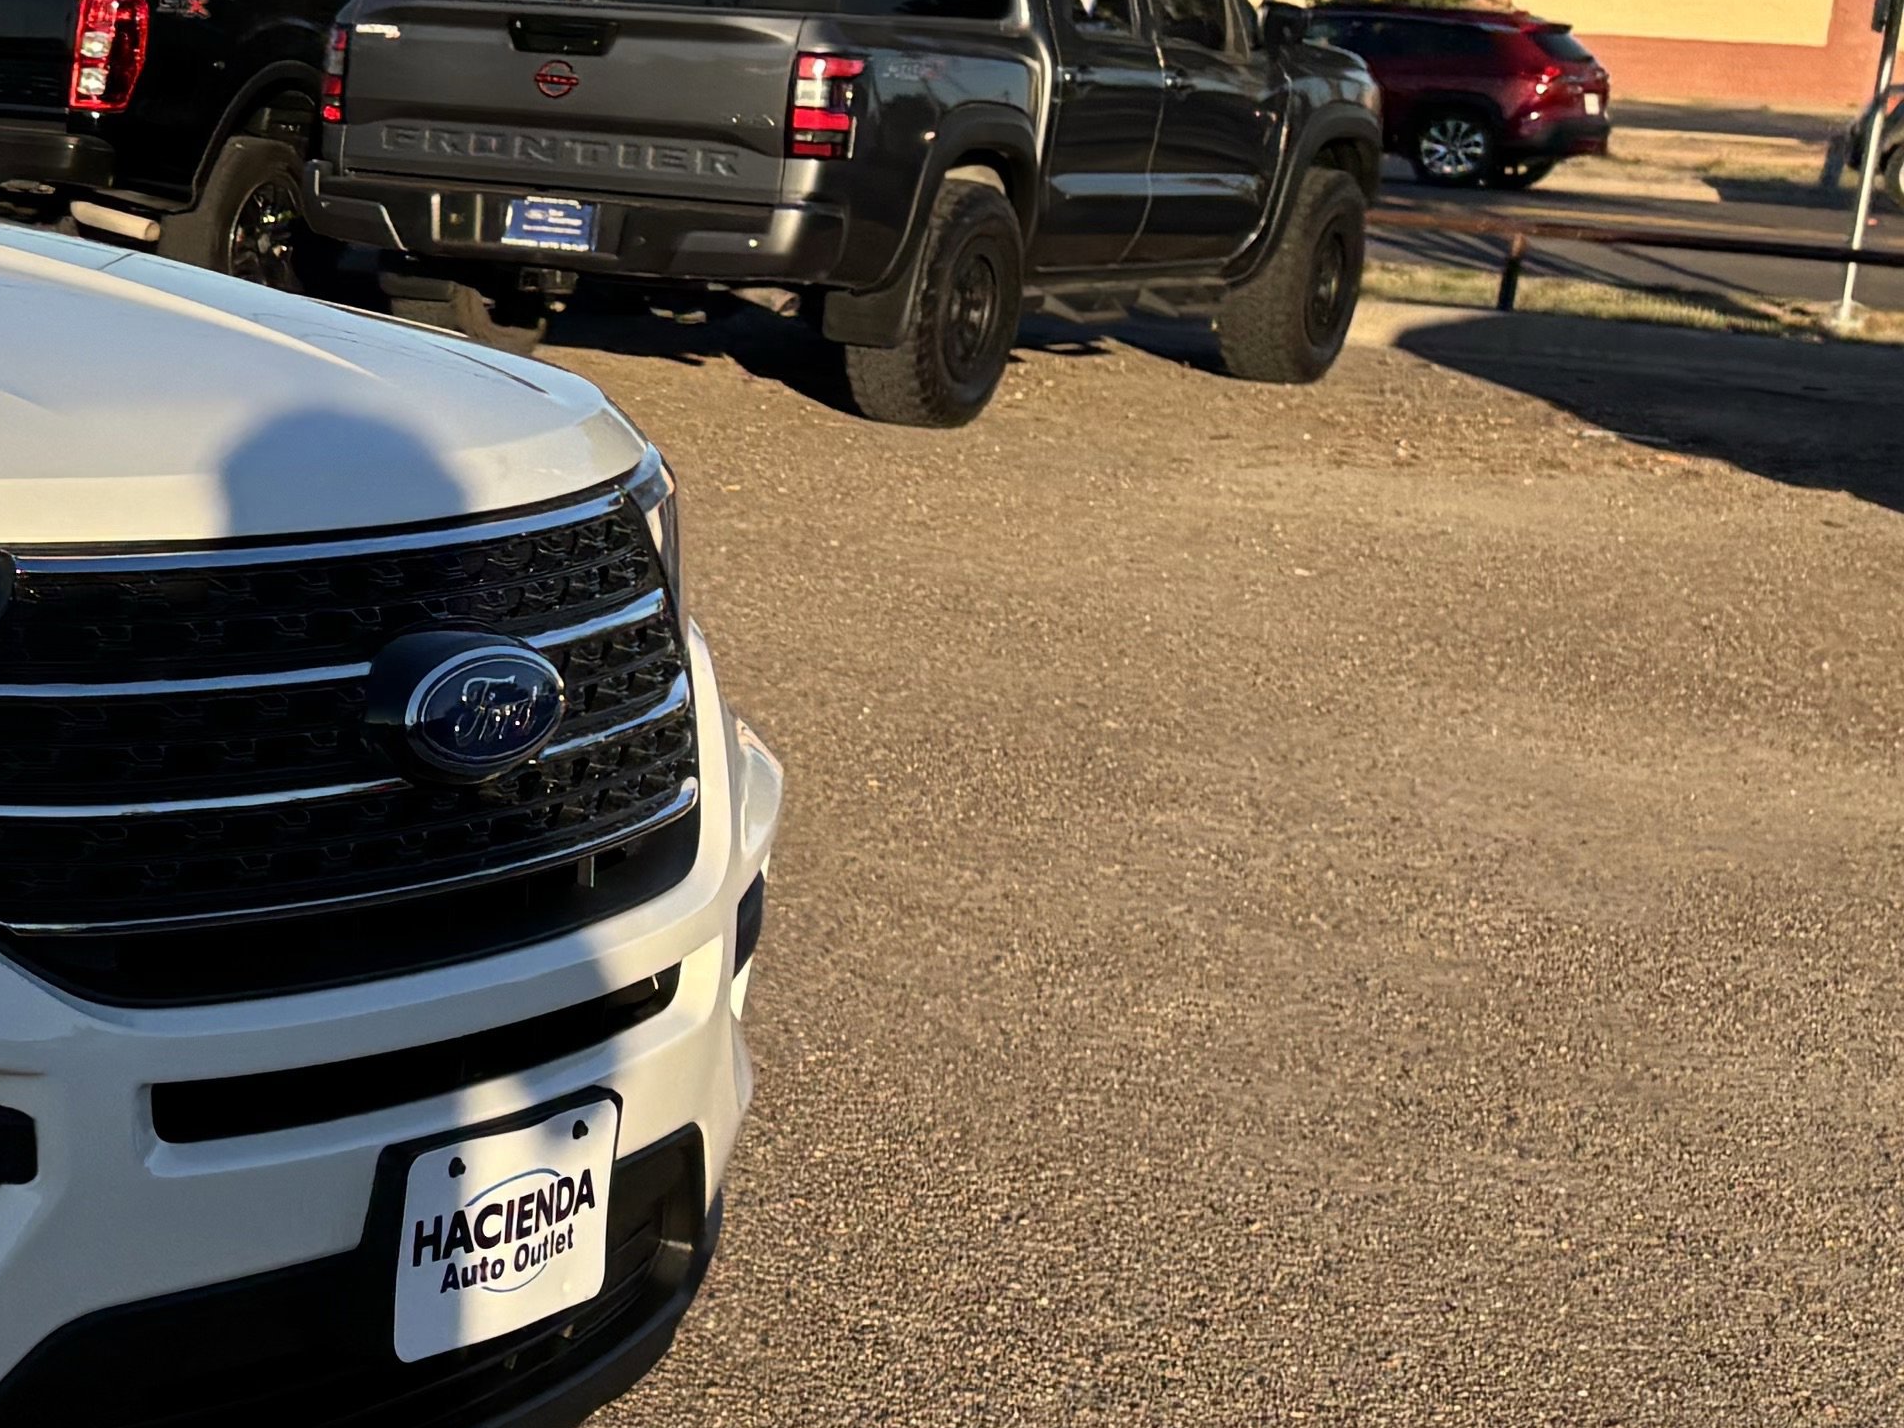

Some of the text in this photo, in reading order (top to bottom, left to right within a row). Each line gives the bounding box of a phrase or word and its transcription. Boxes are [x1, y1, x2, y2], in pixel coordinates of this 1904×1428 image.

[380, 124, 740, 178] FRONTIER
[455, 674, 538, 748] Ford
[412, 1168, 596, 1268] HACIENDA
[440, 1222, 575, 1294] Auto Outlet
